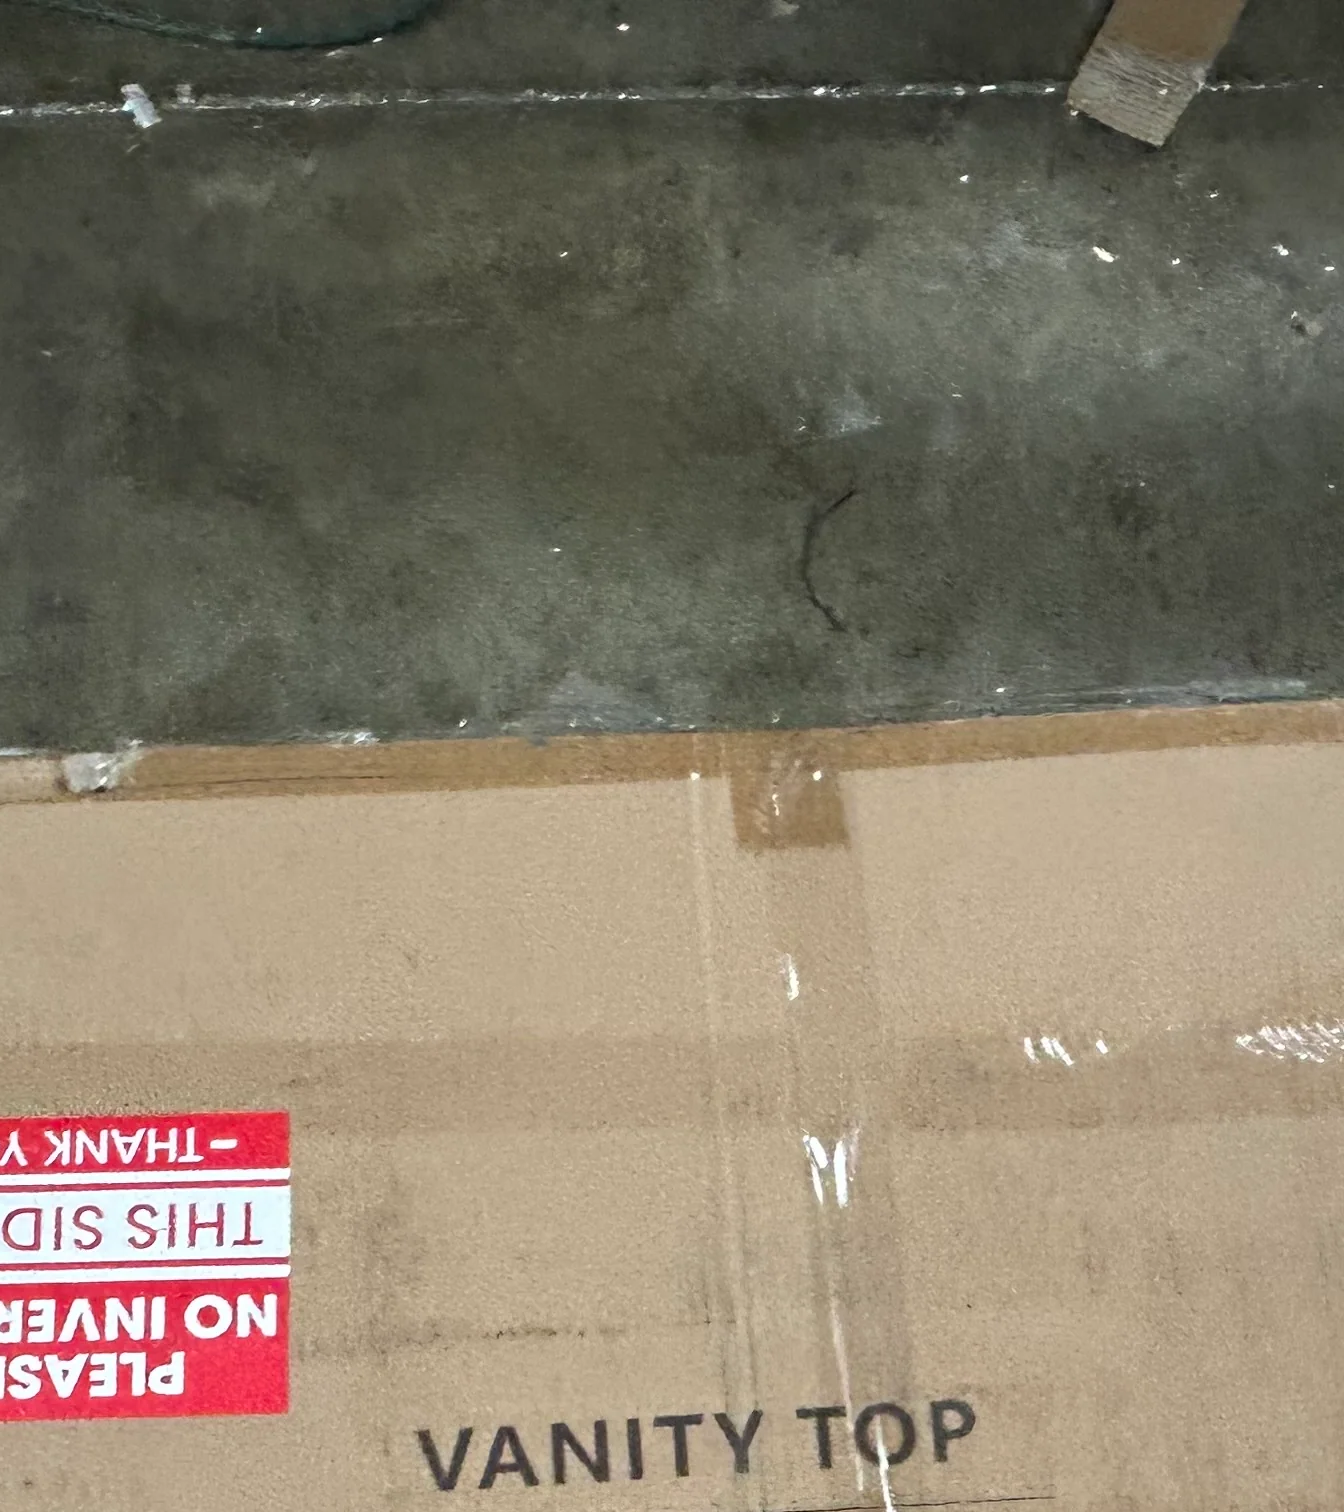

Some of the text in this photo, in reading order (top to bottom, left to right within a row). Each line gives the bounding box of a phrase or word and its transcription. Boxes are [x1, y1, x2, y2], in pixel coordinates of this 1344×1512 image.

[44, 1127, 205, 1166] THANK
[126, 1202, 264, 1250] THIS
[183, 1293, 279, 1338] NO
[414, 1400, 977, 1491] VANITY TOP
